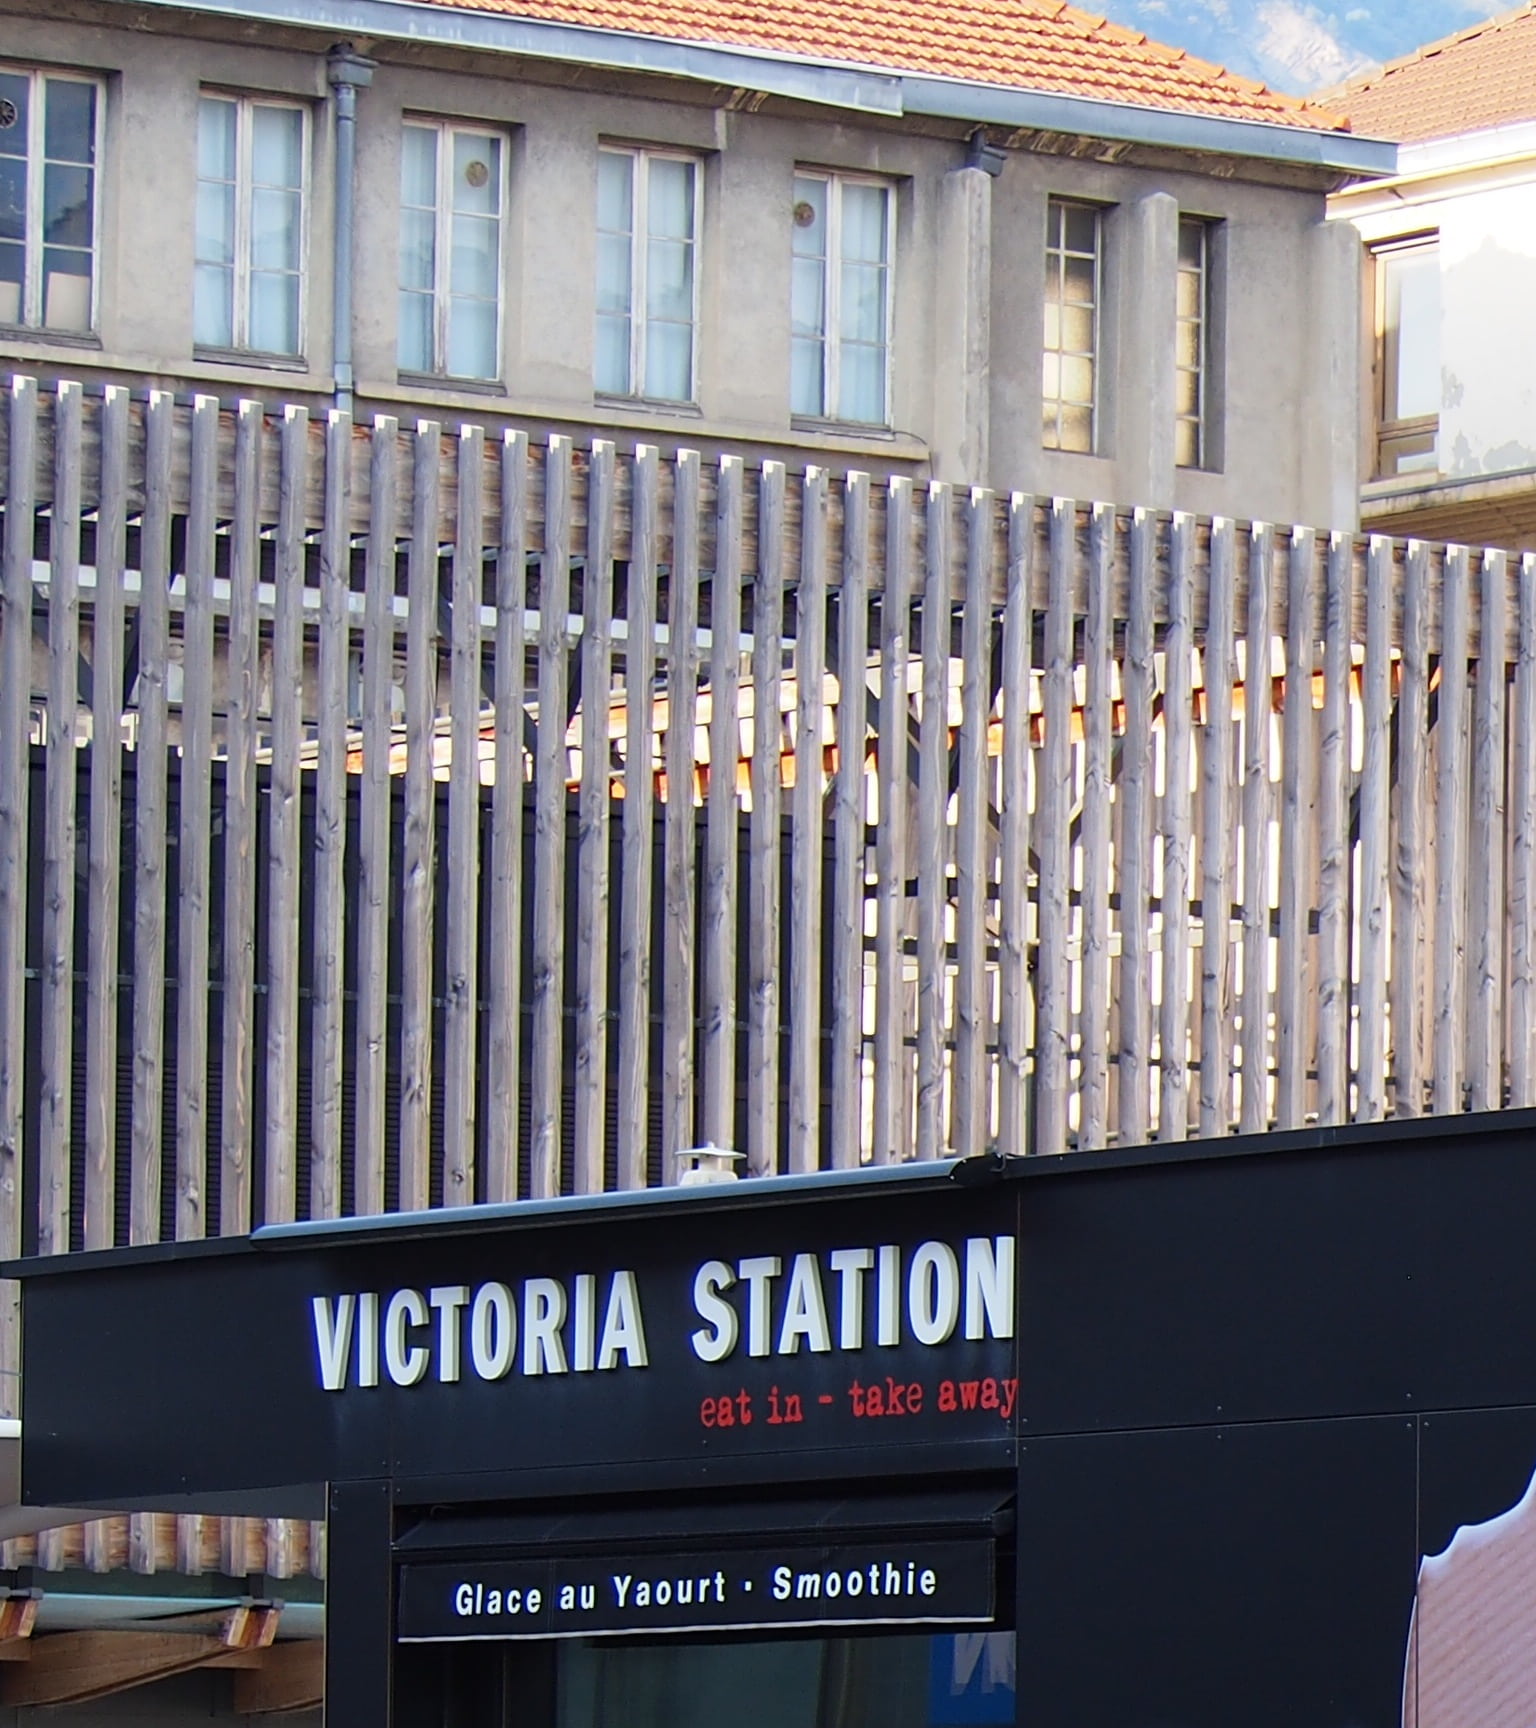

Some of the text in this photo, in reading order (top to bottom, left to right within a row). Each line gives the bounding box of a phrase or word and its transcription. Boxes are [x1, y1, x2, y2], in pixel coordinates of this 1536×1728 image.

[312, 1235, 1017, 1391] VICTORIA STATION
[700, 1376, 1020, 1428] eat in - take away
[455, 1582, 543, 1617] Glace
[559, 1584, 597, 1611] au
[612, 1570, 727, 1608] Yaourt
[772, 1560, 938, 1602] Smoothie
